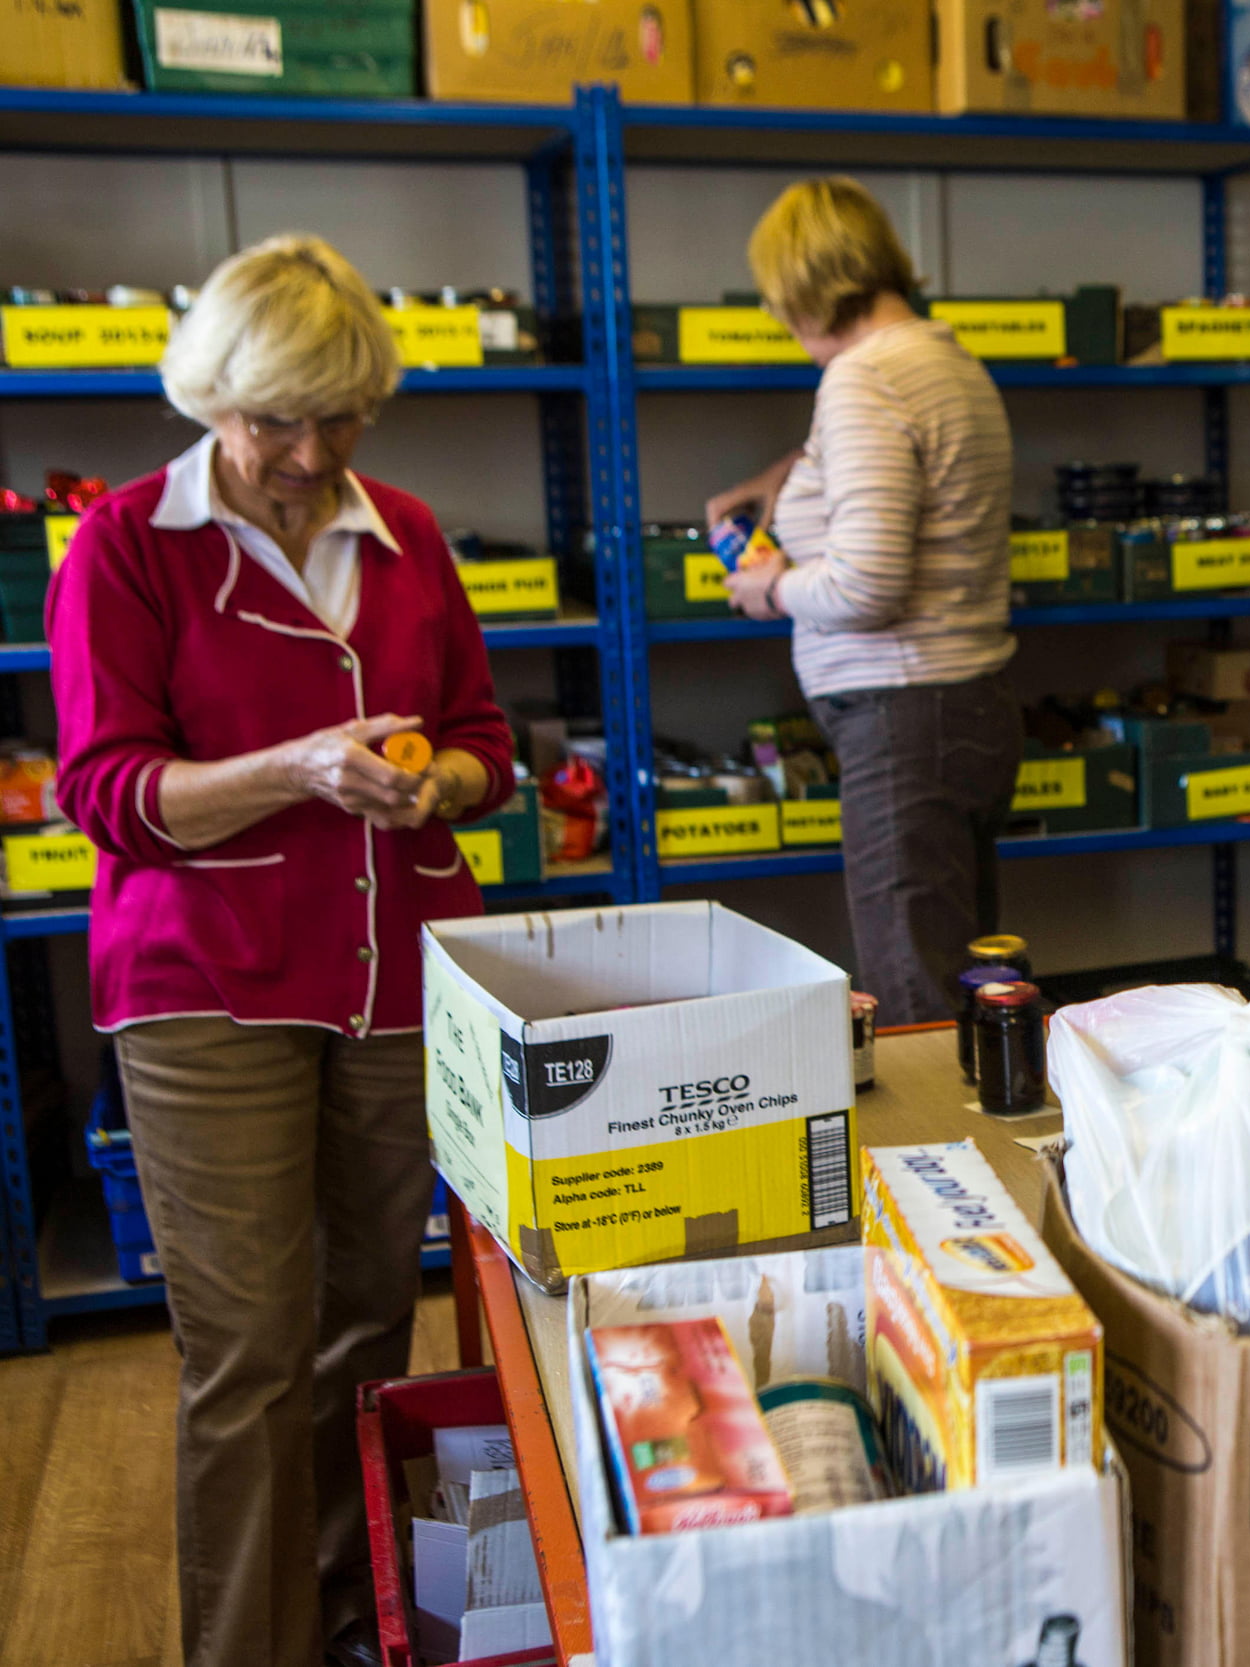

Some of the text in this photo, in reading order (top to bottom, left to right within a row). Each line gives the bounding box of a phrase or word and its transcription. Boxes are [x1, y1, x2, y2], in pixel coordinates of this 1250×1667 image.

[662, 820, 761, 840] POTATOES
[543, 1058, 594, 1083] TE128
[658, 1074, 750, 1103] TESCO
[608, 1092, 799, 1134] Finest Chunky Oven Chips
[674, 1119, 725, 1136] 8 x 1.5 kg
[551, 1160, 664, 1187] Supplier code: 2389
[553, 1182, 646, 1205] Alpha code: TLL
[554, 1220, 581, 1233] Store
[582, 1218, 591, 1229] at
[642, 1210, 653, 1220] or
[654, 1205, 682, 1218] below
[1105, 1369, 1169, 1445] 9200
